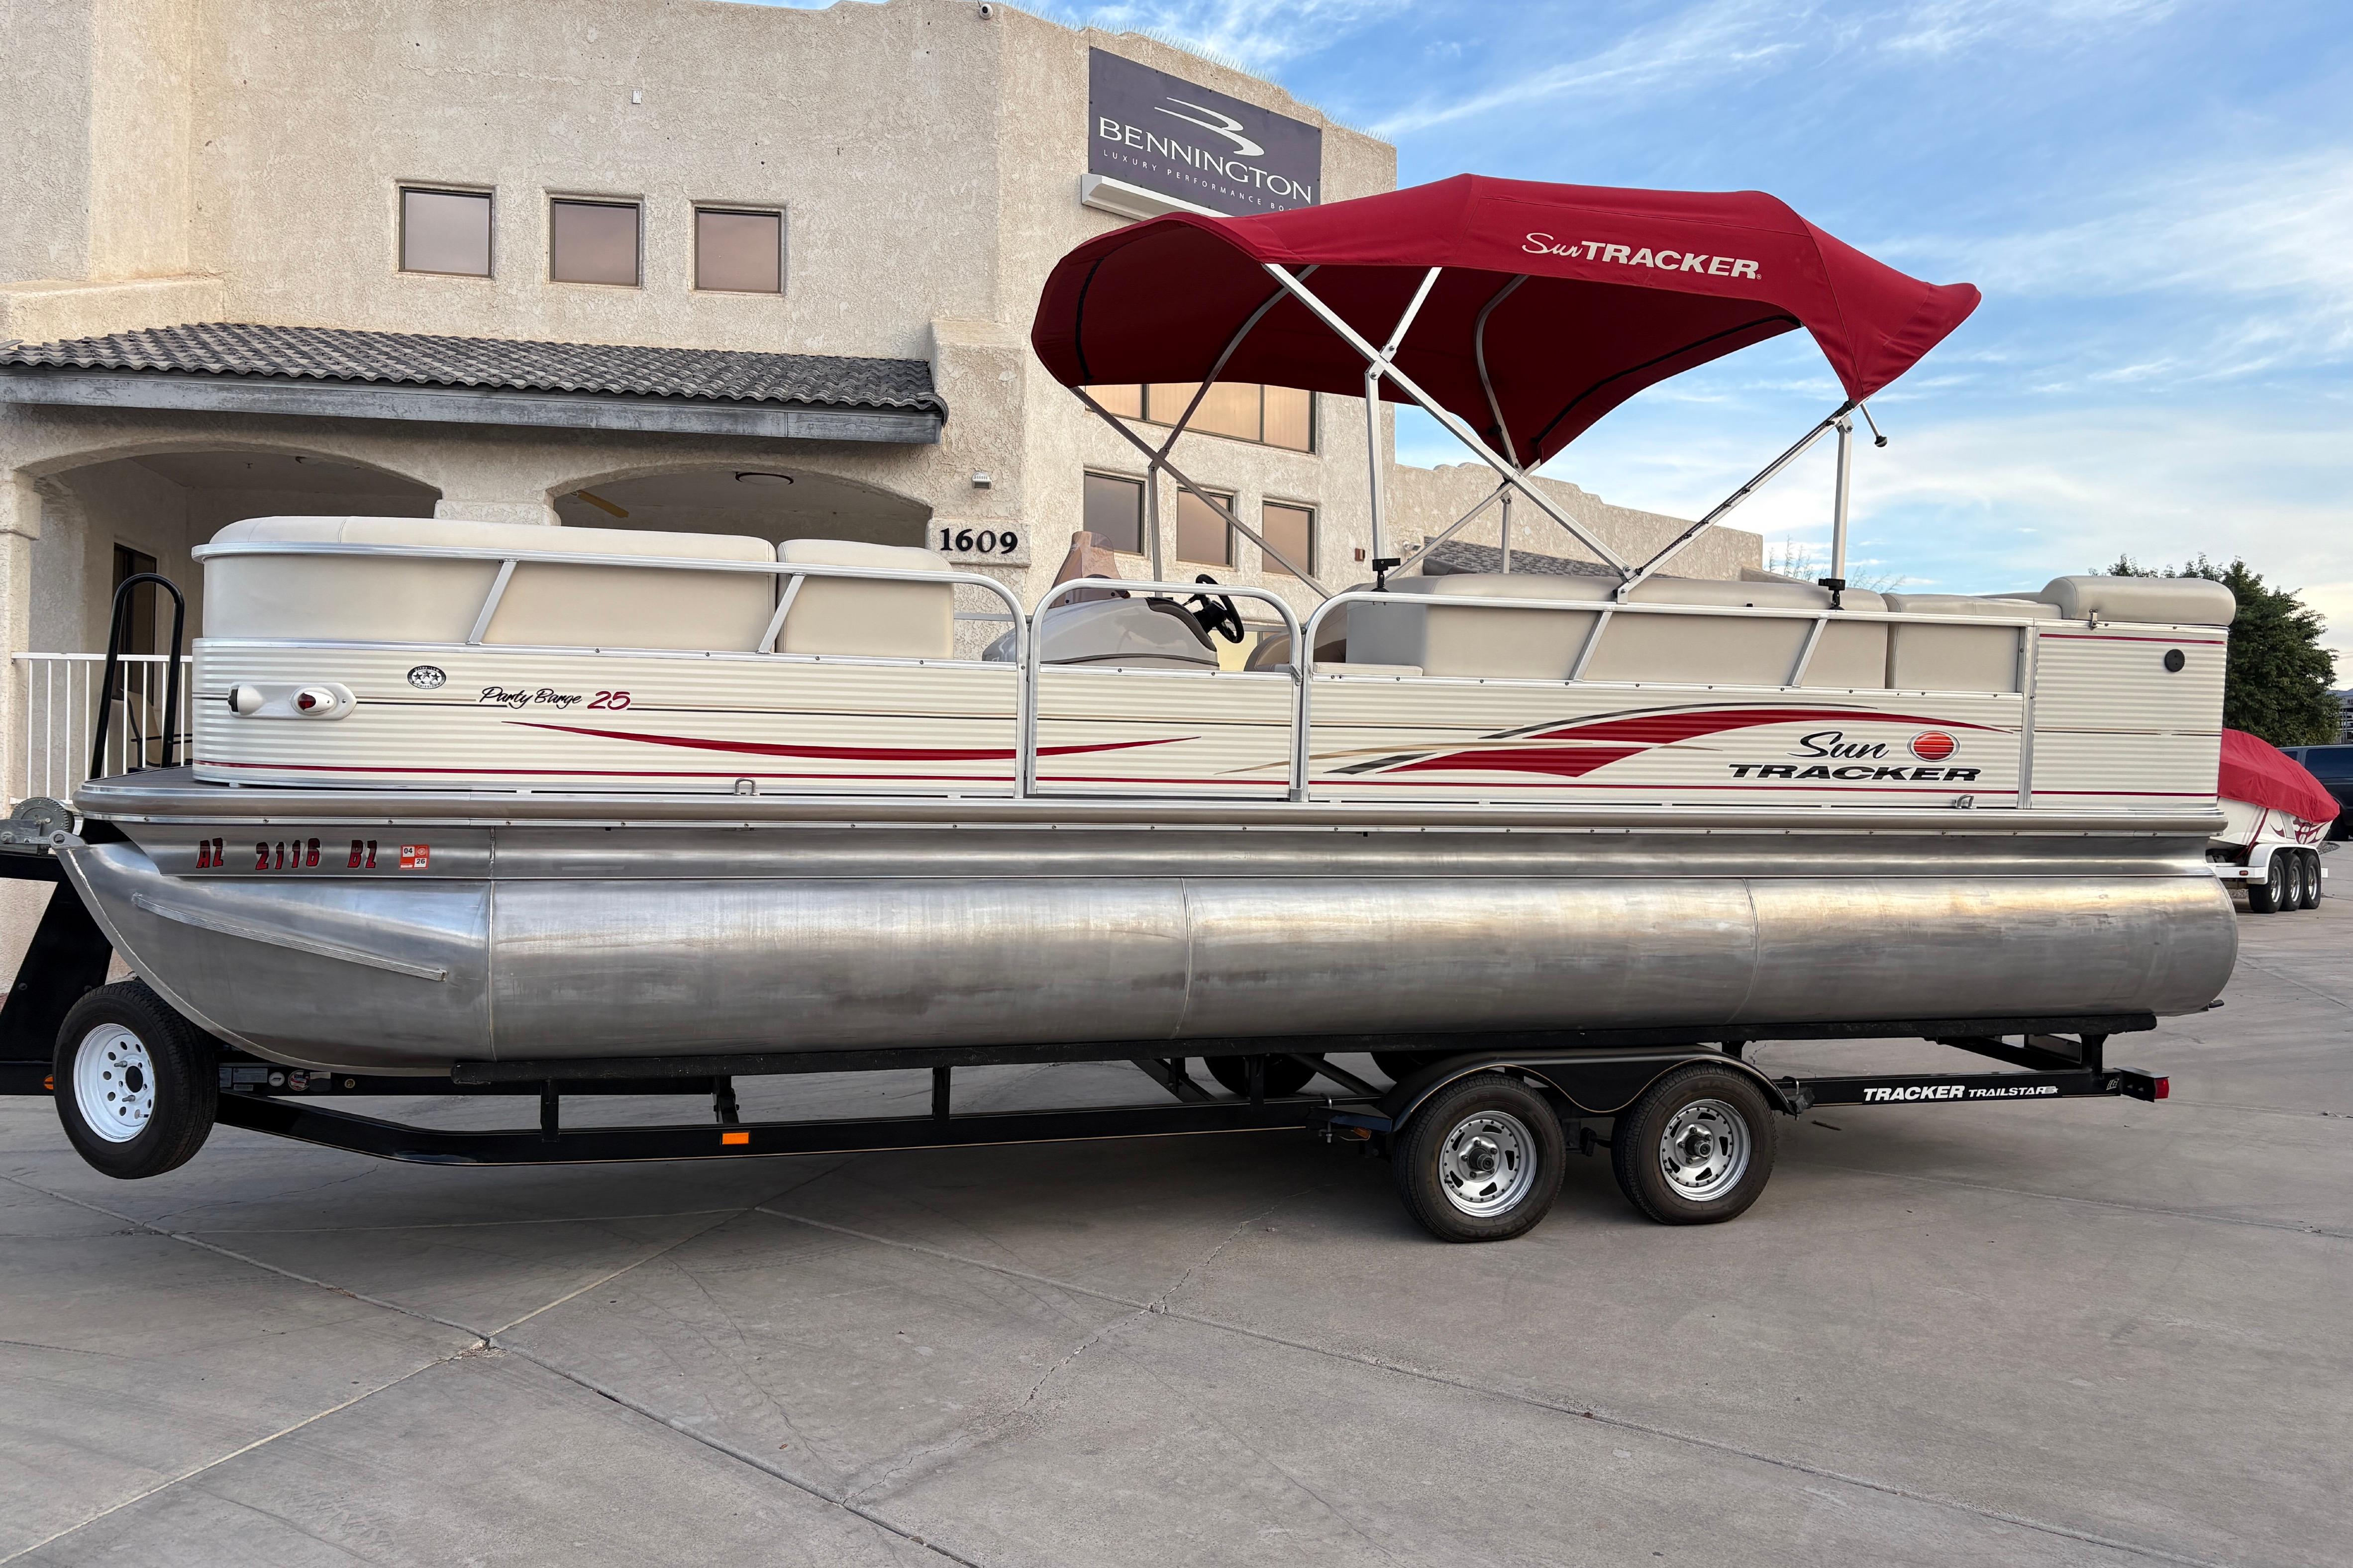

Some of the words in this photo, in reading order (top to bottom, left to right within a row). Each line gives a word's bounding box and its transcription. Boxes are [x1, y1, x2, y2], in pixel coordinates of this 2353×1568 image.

[1099, 116, 1311, 204] BENNINGTON
[1104, 149, 1157, 171] LUXURY
[1167, 169, 1261, 205] PERFORMANCE
[1271, 202, 1291, 211] BO
[940, 527, 1018, 554] 1609
[479, 686, 534, 709] Party
[534, 687, 583, 710] Barge
[587, 690, 631, 710] 25
[1786, 731, 1890, 759] Sun
[1728, 764, 1982, 782] TRACKER
[196, 838, 223, 869] AZ
[255, 838, 321, 871] 2116
[347, 840, 378, 869] BZ
[1863, 1085, 1965, 1101] TRACKER
[1968, 1086, 2047, 1097] TRAILSTAR
